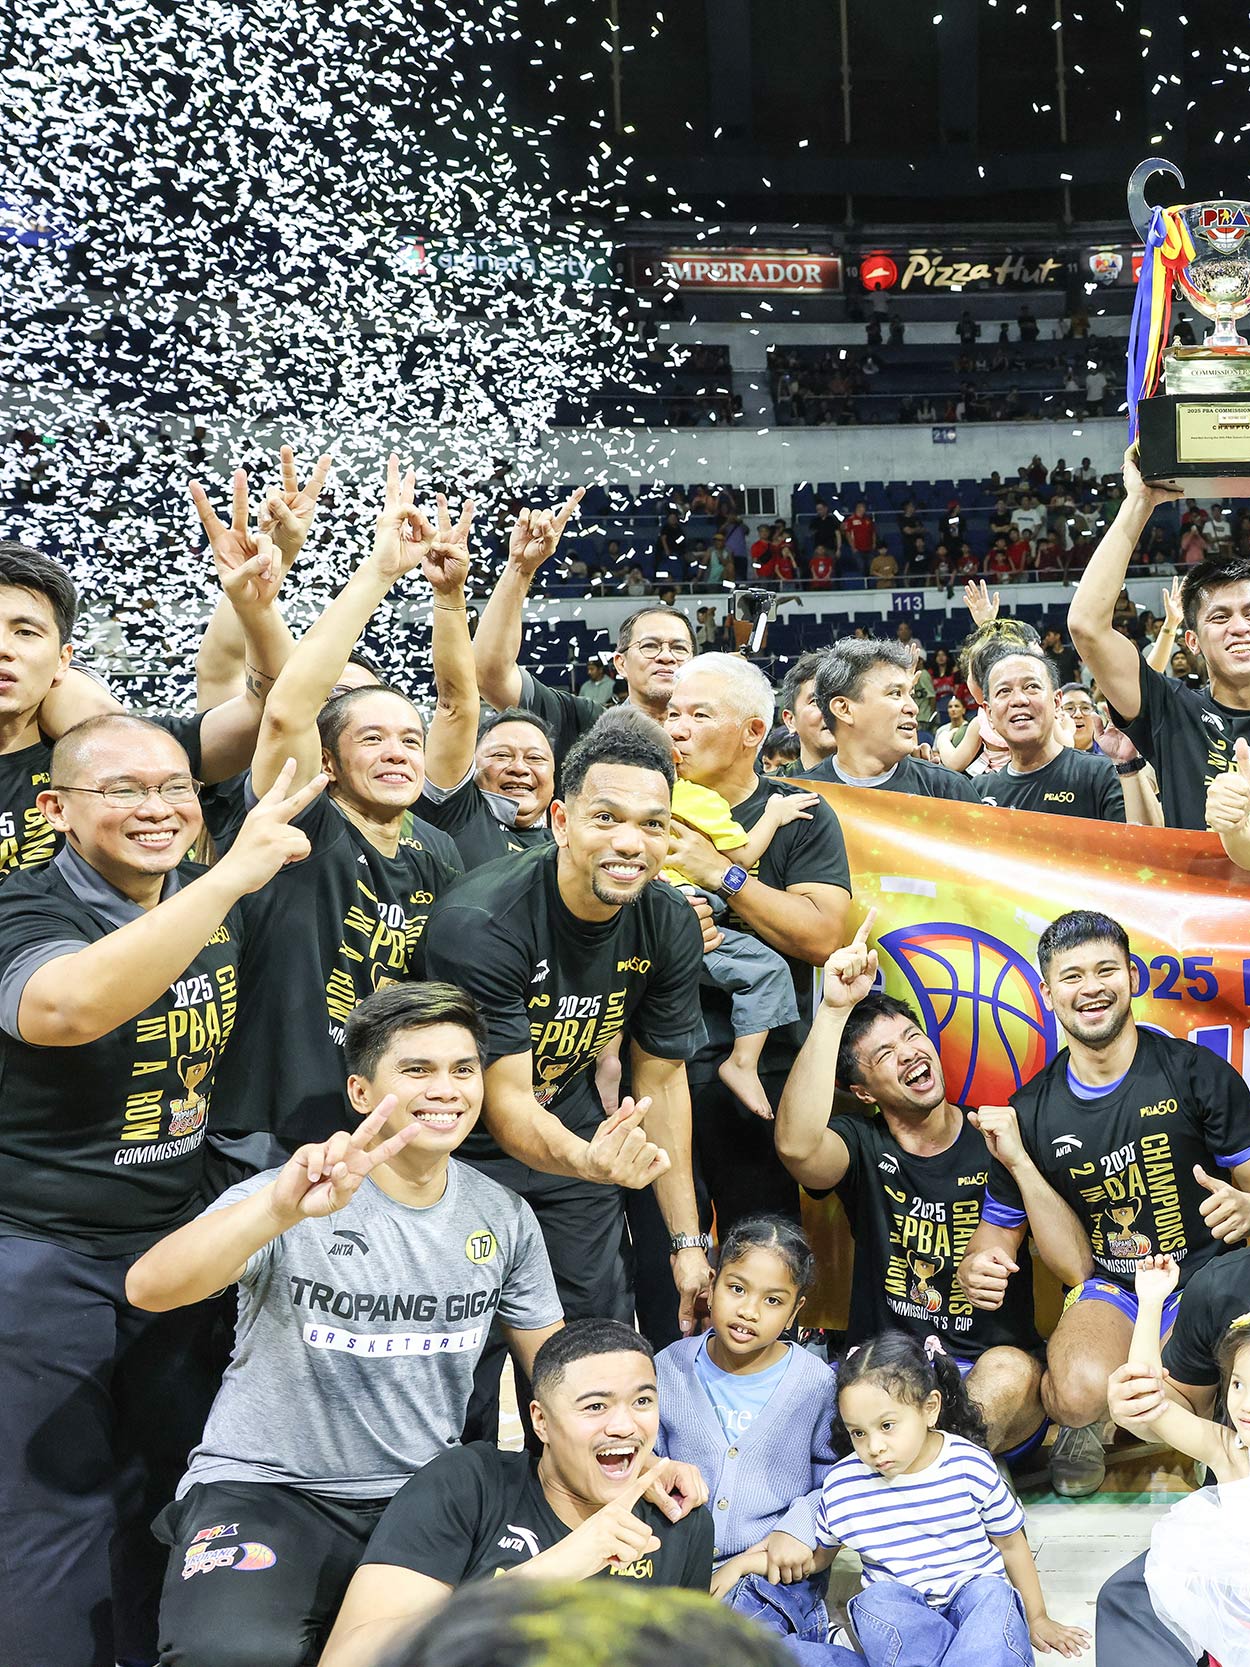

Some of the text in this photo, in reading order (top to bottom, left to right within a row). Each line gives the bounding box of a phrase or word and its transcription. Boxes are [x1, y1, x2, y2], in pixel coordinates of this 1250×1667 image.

[1202, 207, 1250, 228] PBA
[901, 255, 1062, 290] Pizza Hut
[894, 596, 923, 612] 113
[1129, 953, 1219, 1002] 025
[554, 994, 603, 1021] 2025
[167, 1001, 222, 1058] PBA
[535, 1018, 598, 1057] PBA
[120, 1016, 168, 1142] IN A ROW
[1139, 1098, 1178, 1118] PBA50
[878, 1161, 897, 1175] ANTA
[1068, 1161, 1096, 1180] 2
[1140, 1132, 1188, 1253] CHAMPIONS
[471, 1234, 492, 1260] 17
[902, 1215, 951, 1257] PBA
[328, 1244, 354, 1256] ANTA
[290, 1275, 501, 1323] TROPANG GIGA
[954, 1316, 974, 1332] CUP
[309, 1329, 478, 1353] BASKETBALL
[498, 1535, 525, 1552] ANTA
